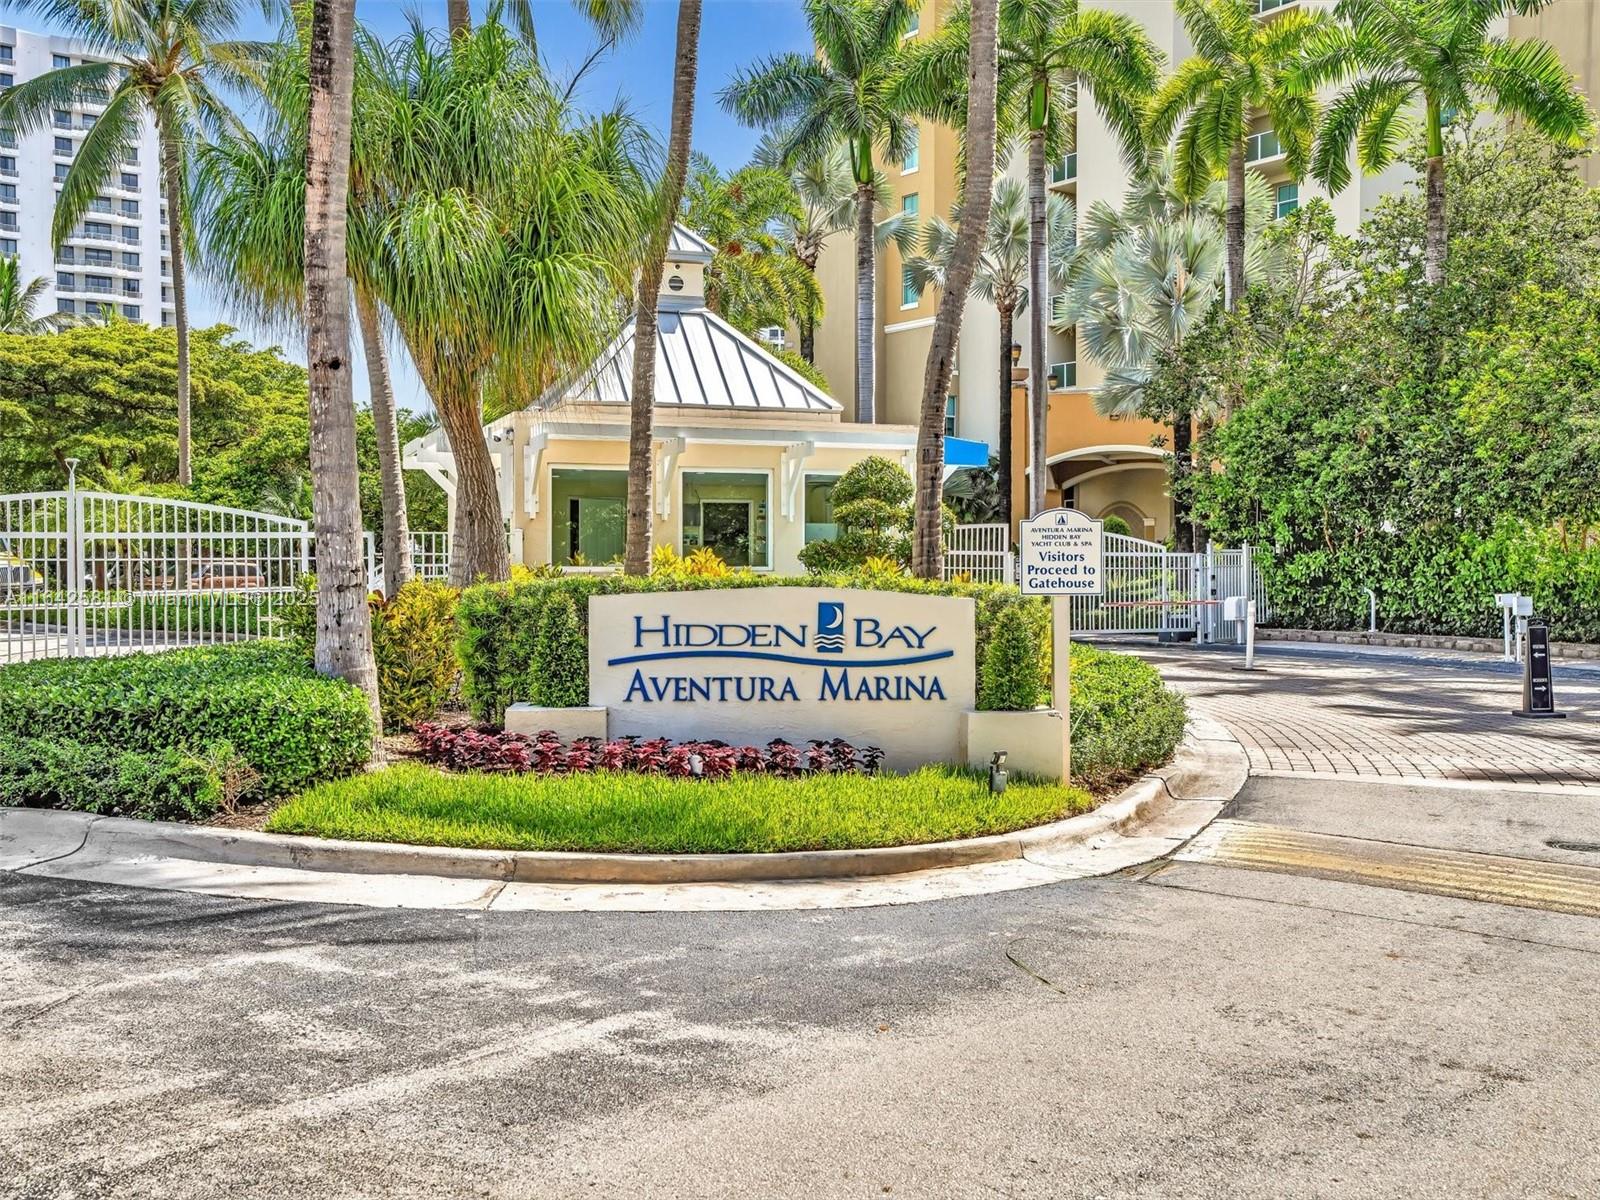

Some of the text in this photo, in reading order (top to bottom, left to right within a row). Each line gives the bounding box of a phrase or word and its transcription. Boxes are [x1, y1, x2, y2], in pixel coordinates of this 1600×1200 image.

[1039, 551, 1085, 562] Visitors
[1027, 564, 1096, 575] Proceed to
[1029, 577, 1095, 589] Gatehouse
